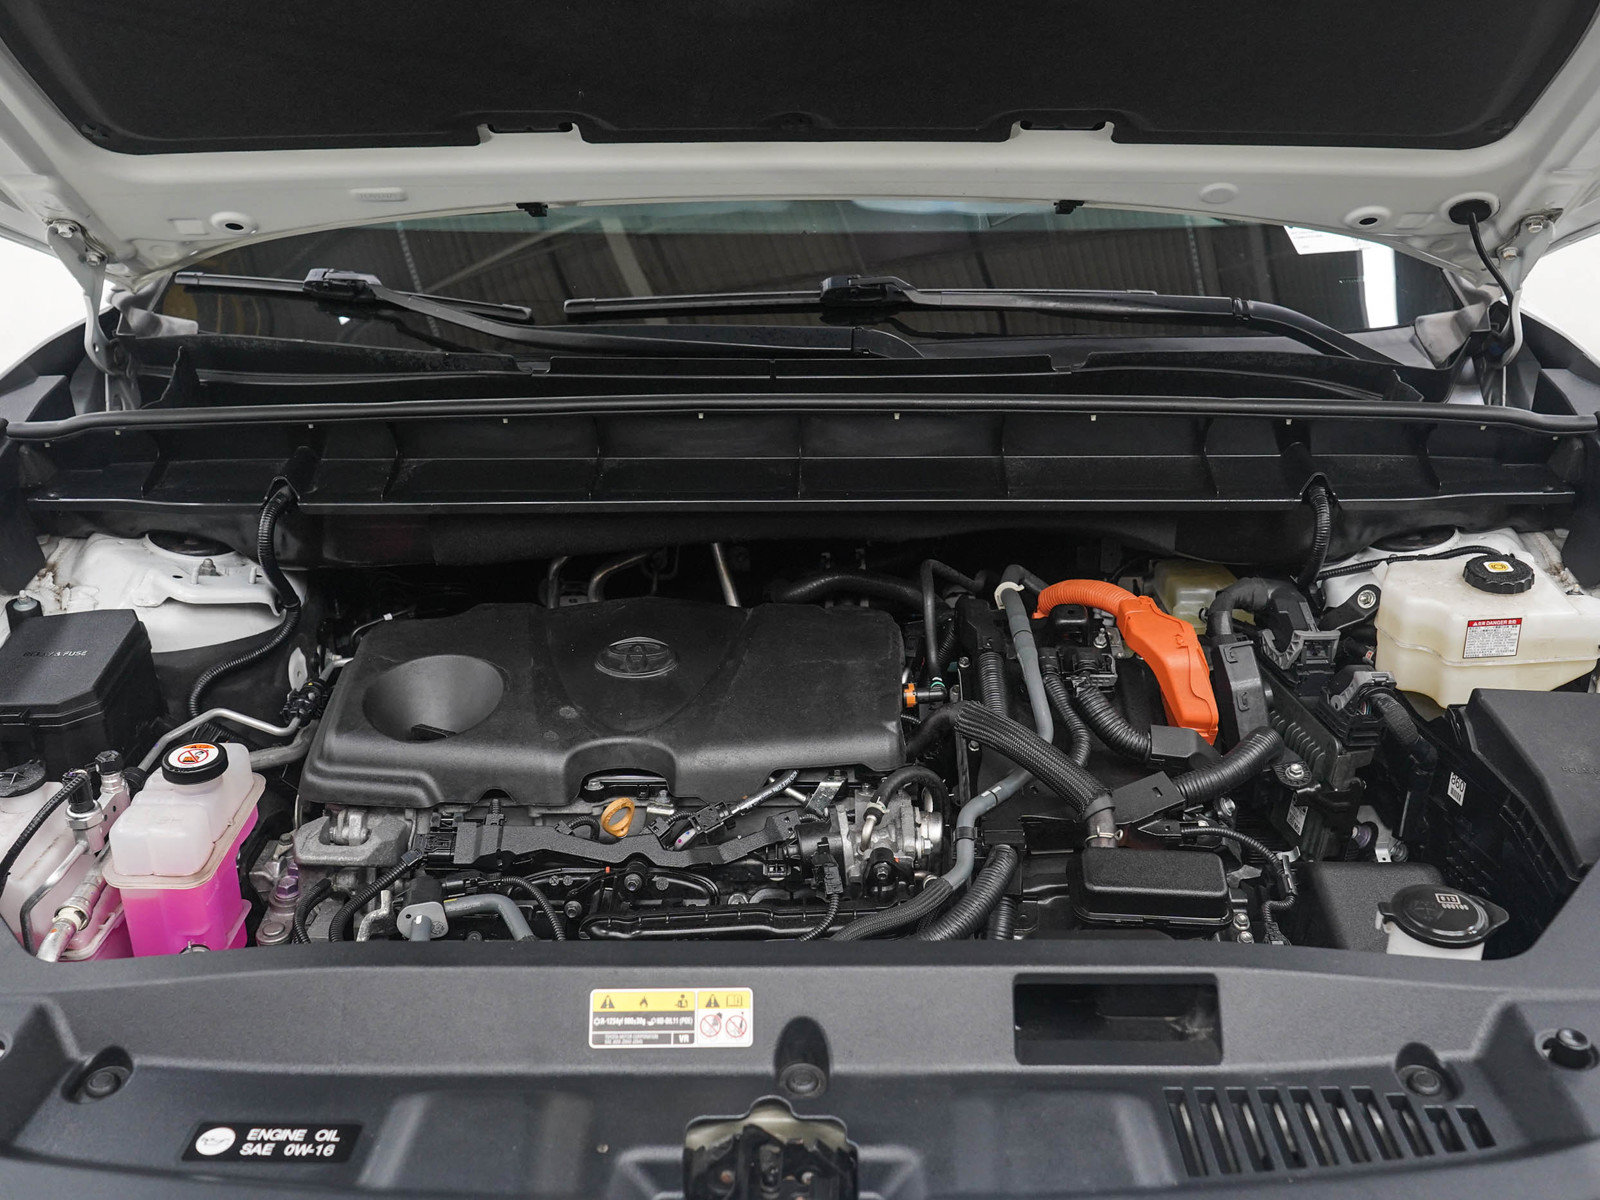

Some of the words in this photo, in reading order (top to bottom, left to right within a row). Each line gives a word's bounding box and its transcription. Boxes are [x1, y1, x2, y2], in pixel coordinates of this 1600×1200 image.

[678, 1034, 690, 1043] VR
[246, 1128, 308, 1142] ENGINE
[314, 1129, 341, 1142] OIL
[239, 1143, 276, 1156] SAE
[283, 1143, 336, 1157] 0W-16
